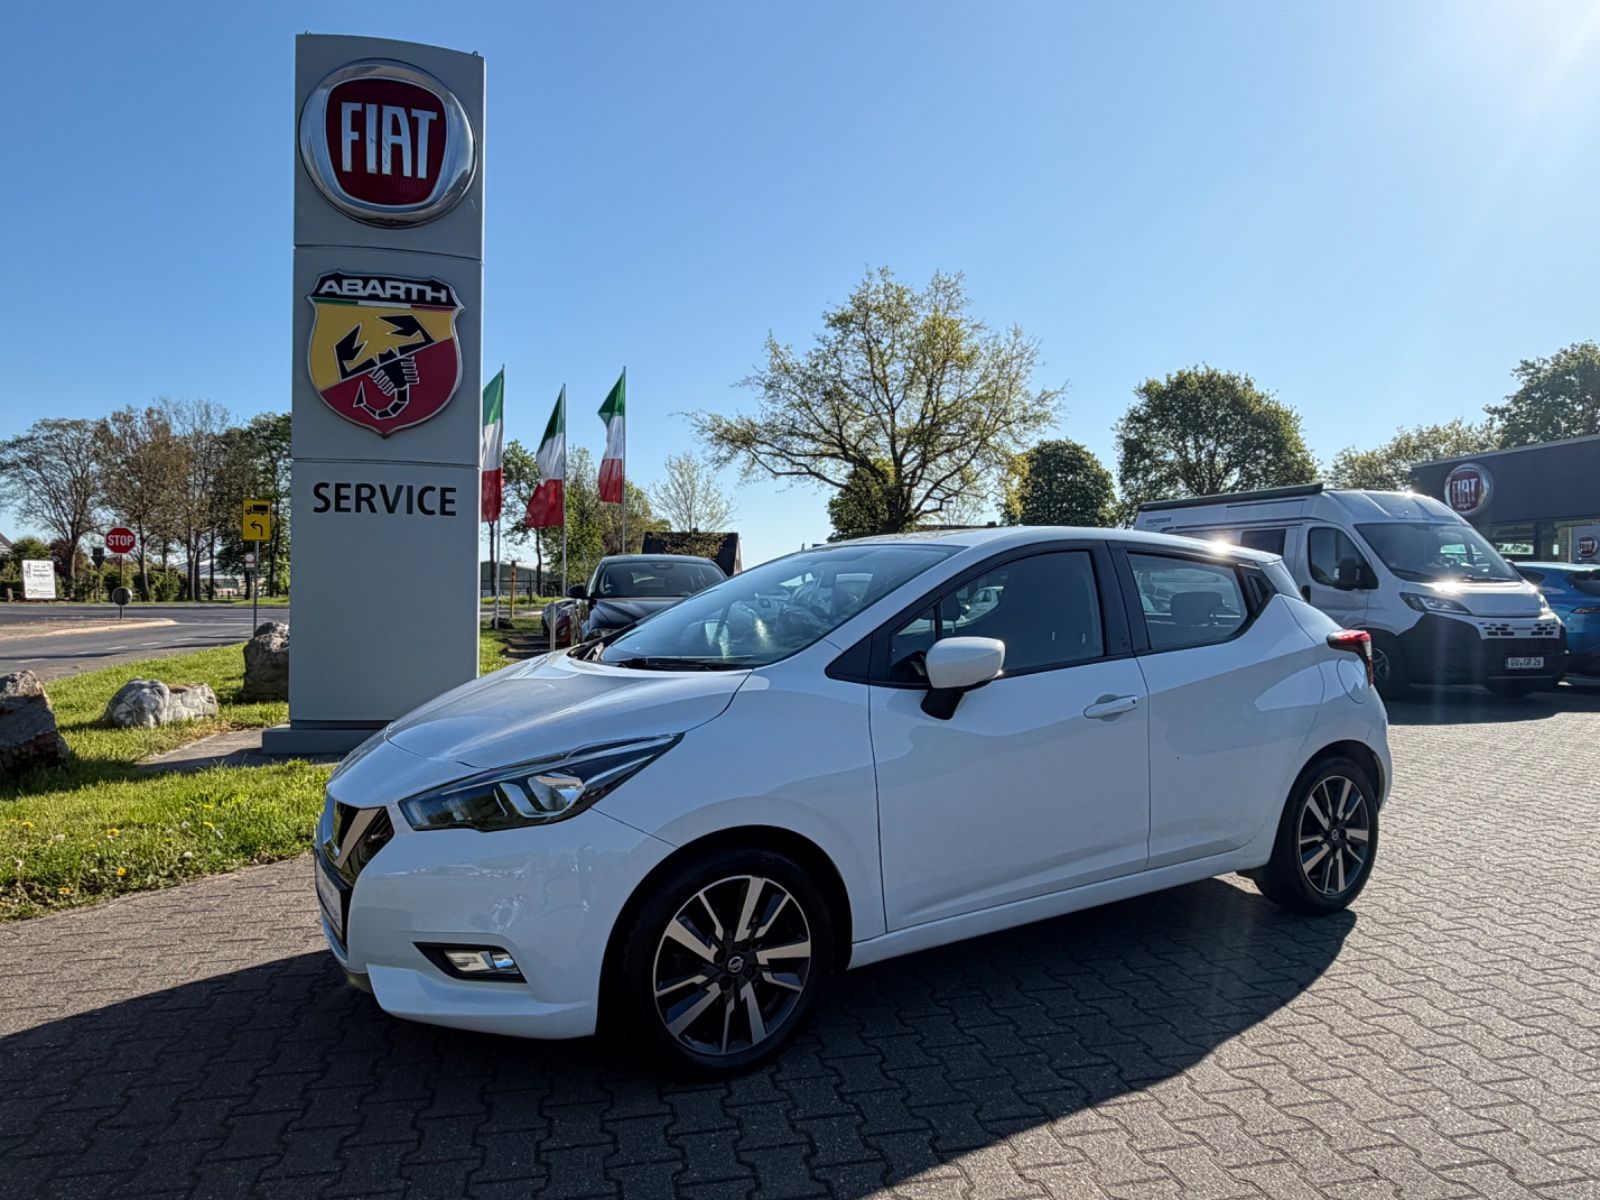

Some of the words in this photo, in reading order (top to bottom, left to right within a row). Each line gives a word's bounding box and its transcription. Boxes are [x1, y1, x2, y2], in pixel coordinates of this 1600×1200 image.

[341, 101, 438, 179] FIAT
[318, 278, 448, 303] ABARTH
[312, 481, 457, 516] SERVICE
[1451, 478, 1478, 503] FIAT
[107, 534, 134, 546] STOP
